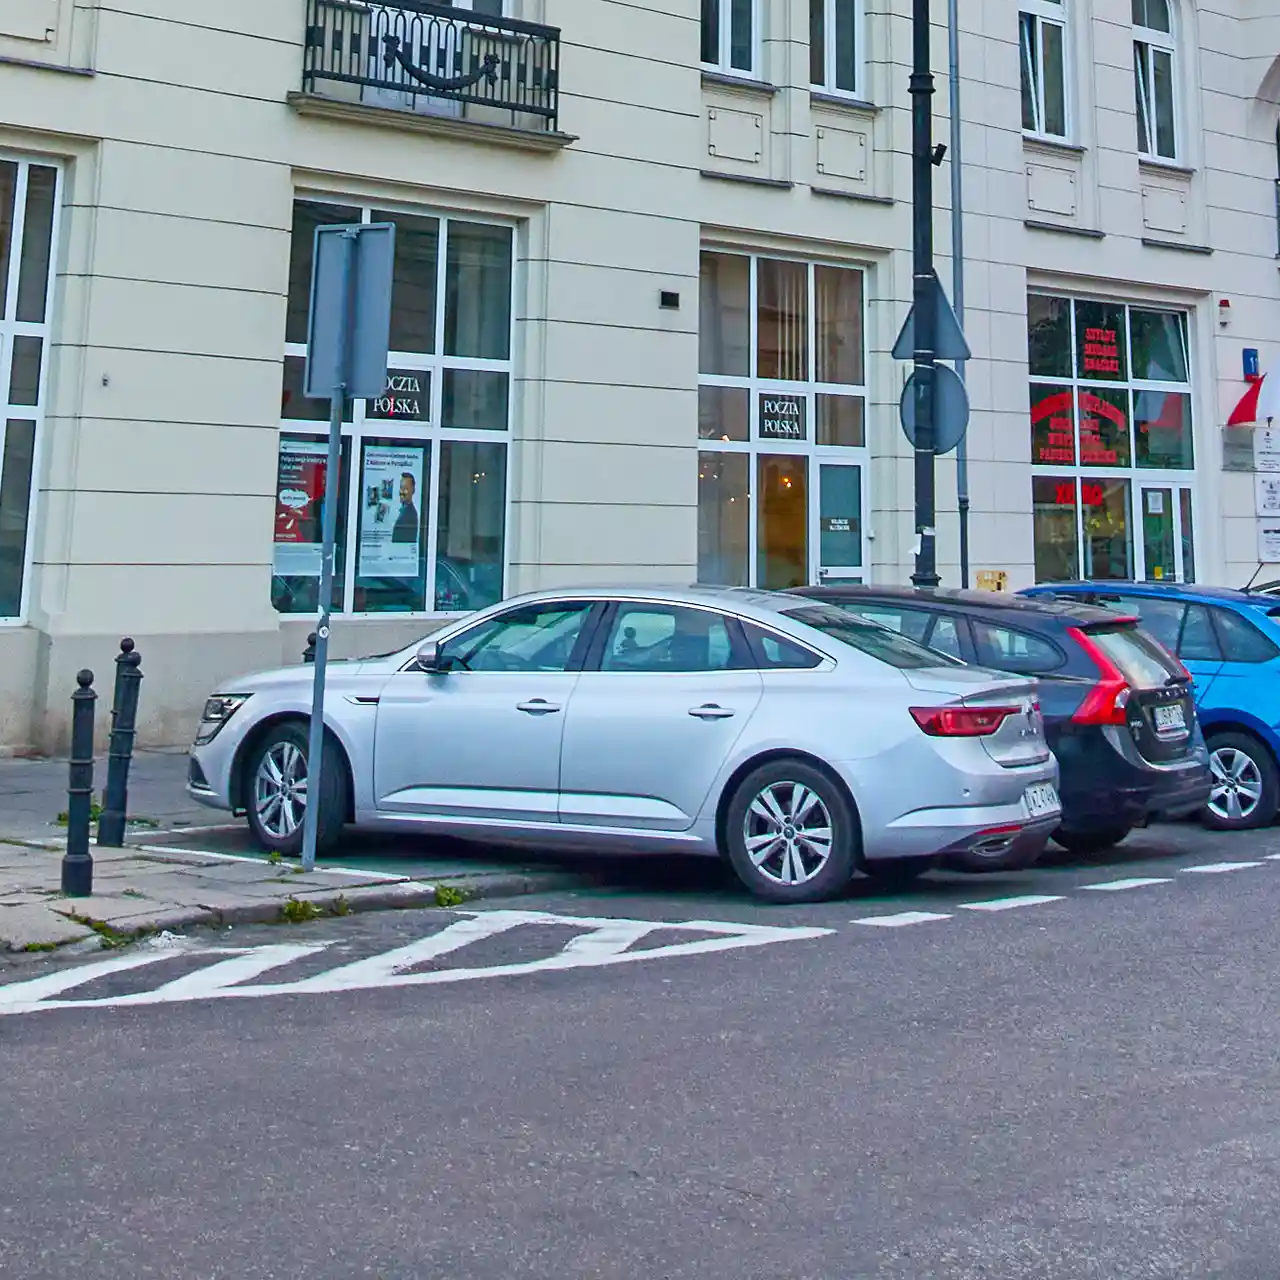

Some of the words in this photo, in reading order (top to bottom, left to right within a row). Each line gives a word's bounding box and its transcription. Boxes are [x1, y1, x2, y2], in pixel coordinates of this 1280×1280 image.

[384, 376, 420, 392] OCZTA
[373, 397, 420, 414] POLSKA
[764, 400, 799, 415] POCZTA
[764, 419, 800, 434] POLSKA
